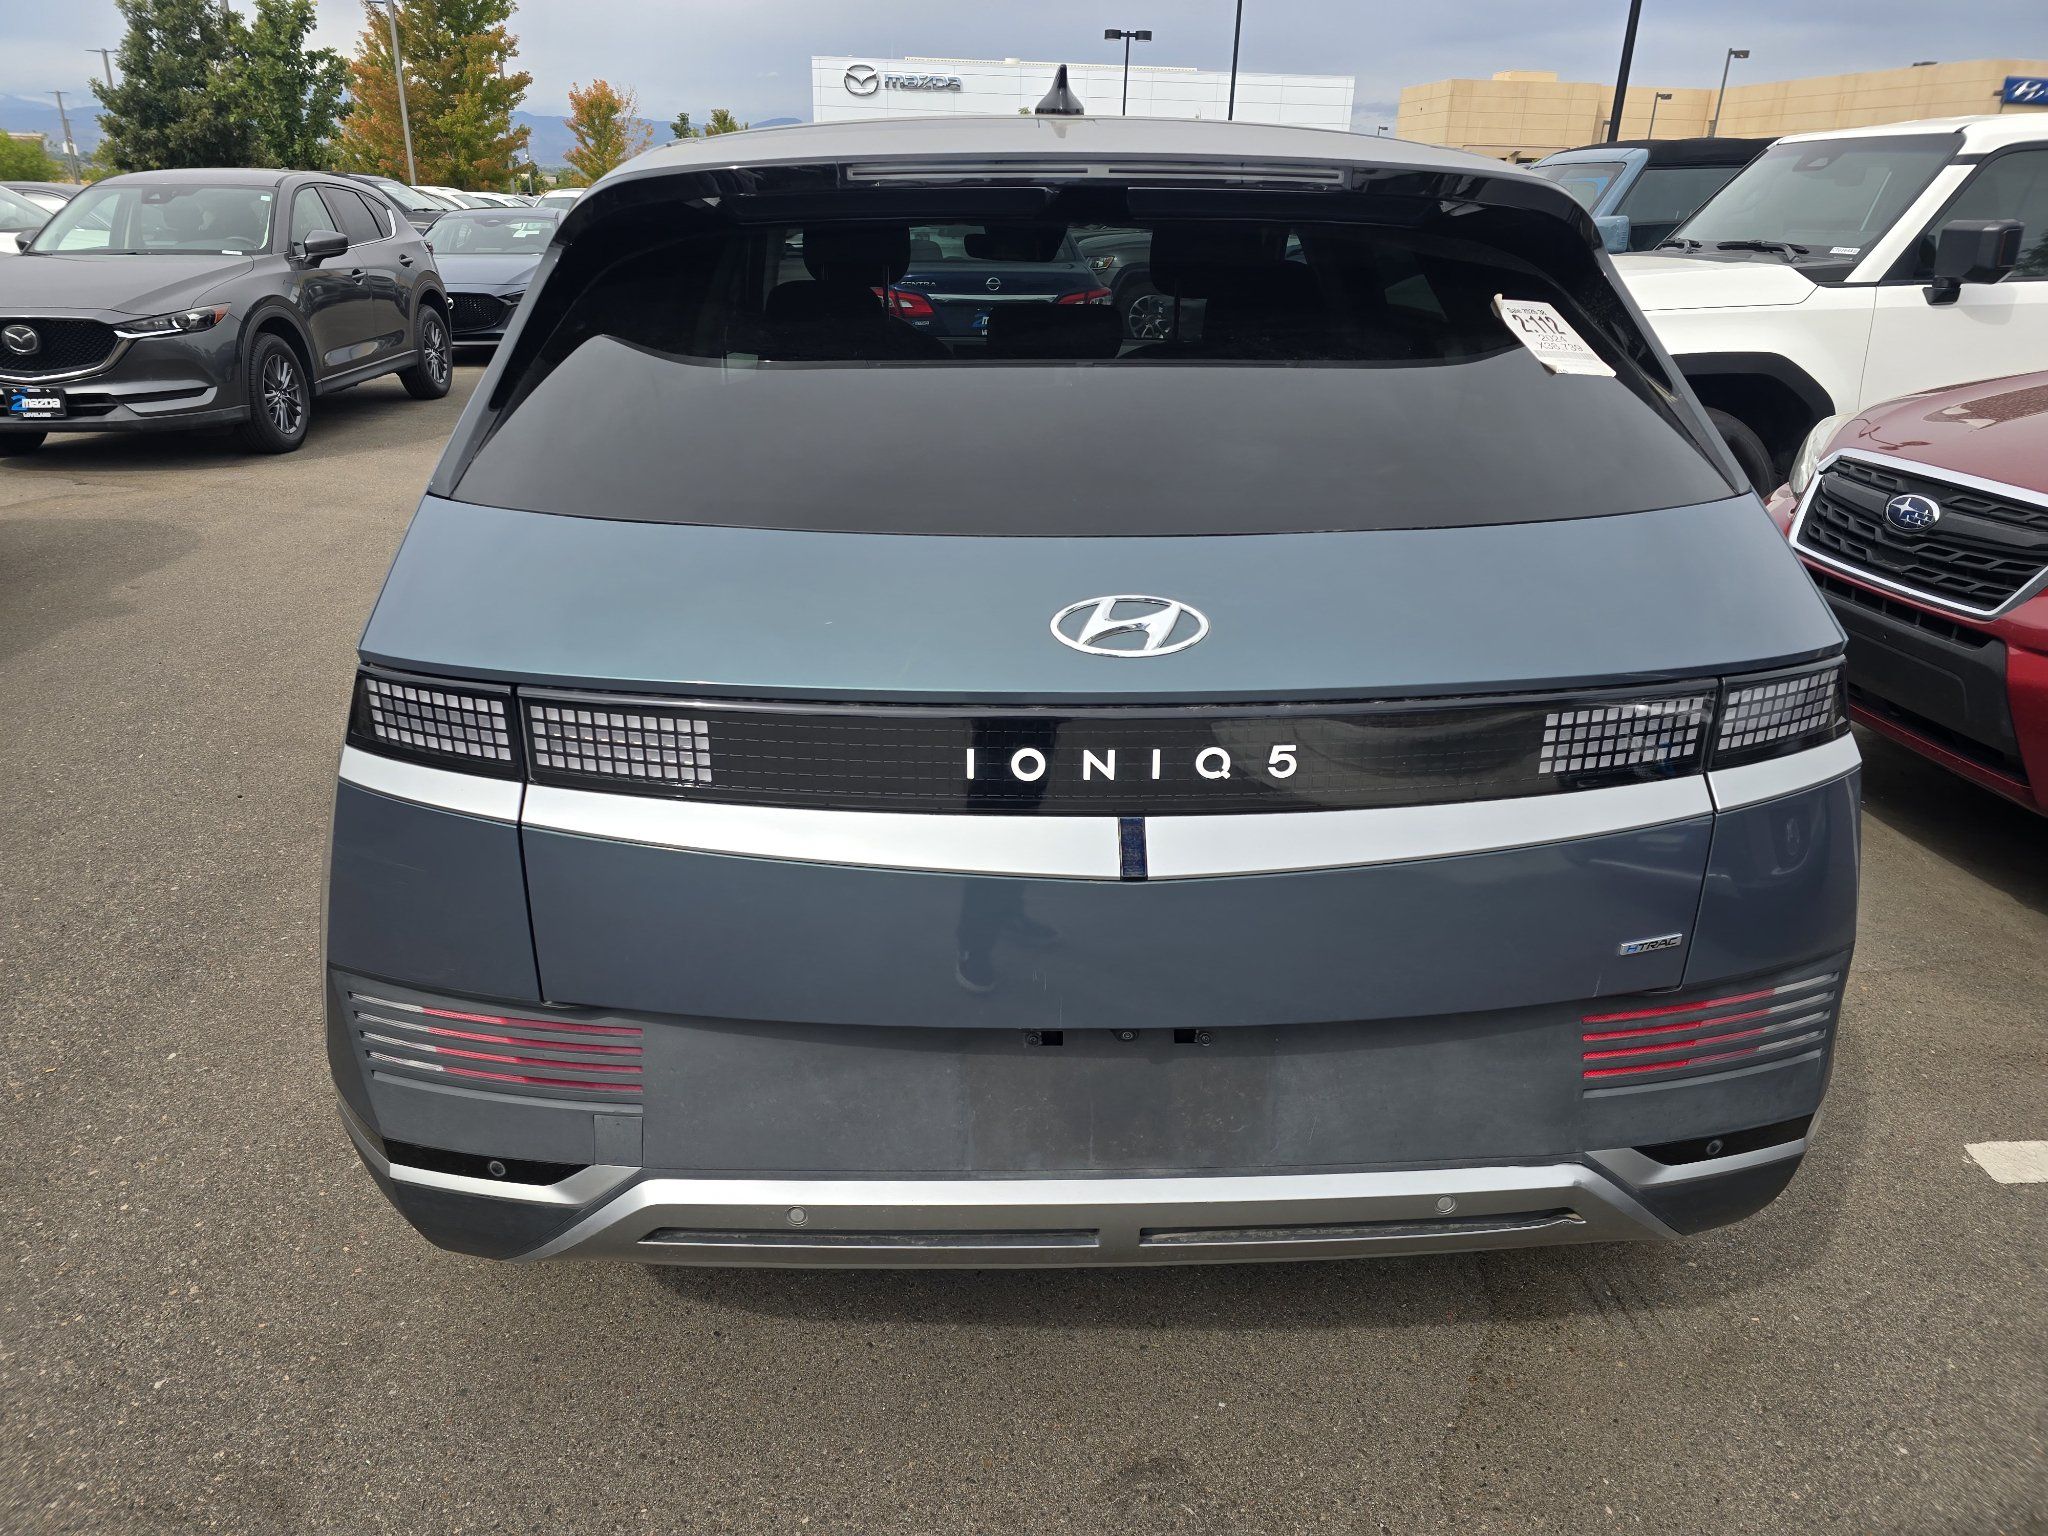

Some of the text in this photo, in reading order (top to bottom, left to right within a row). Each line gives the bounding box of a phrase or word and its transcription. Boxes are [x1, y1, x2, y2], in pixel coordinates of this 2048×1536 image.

[884, 73, 961, 91] mazda
[1512, 314, 1567, 335] 2:112
[1538, 334, 1567, 343] 2024
[22, 398, 61, 409] mazda
[966, 744, 1297, 782] IONIQ 5
[1626, 937, 1678, 953] HTRAC
